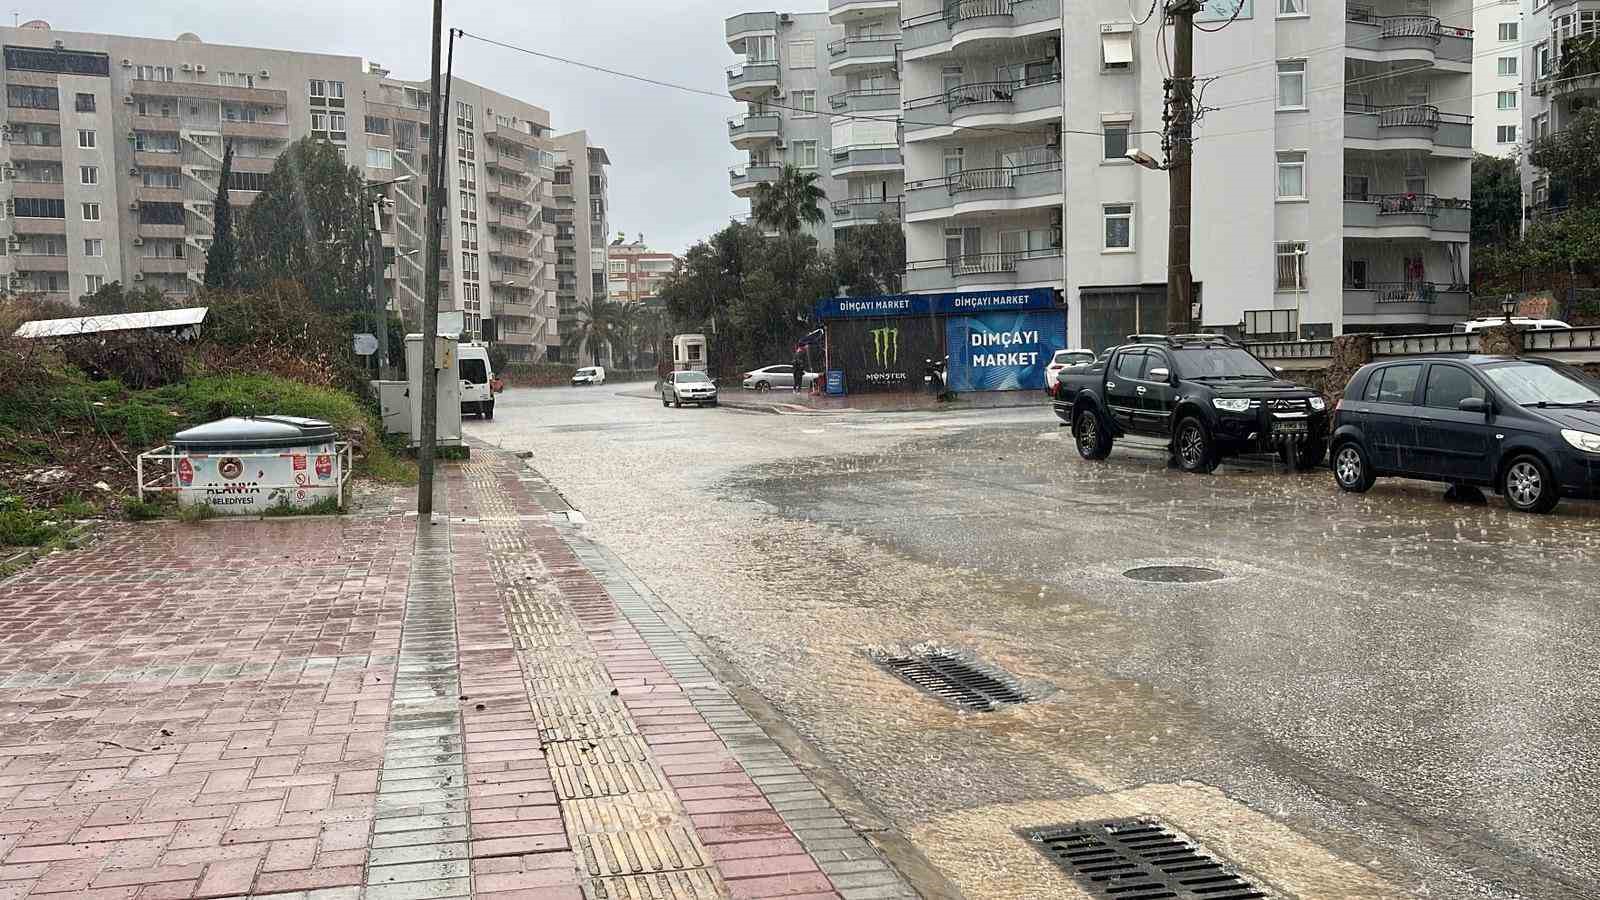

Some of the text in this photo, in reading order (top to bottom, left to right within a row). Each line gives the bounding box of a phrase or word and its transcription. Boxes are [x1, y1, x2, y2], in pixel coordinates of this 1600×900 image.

[840, 299, 909, 312] DİMÇAYI MARKET
[954, 295, 1029, 308] DİMÇAYI MARKET
[971, 330, 1038, 348] DİMÇAYI
[972, 351, 1038, 367] MARKET
[865, 372, 906, 380] MONSTER
[206, 482, 260, 494] ALANYA
